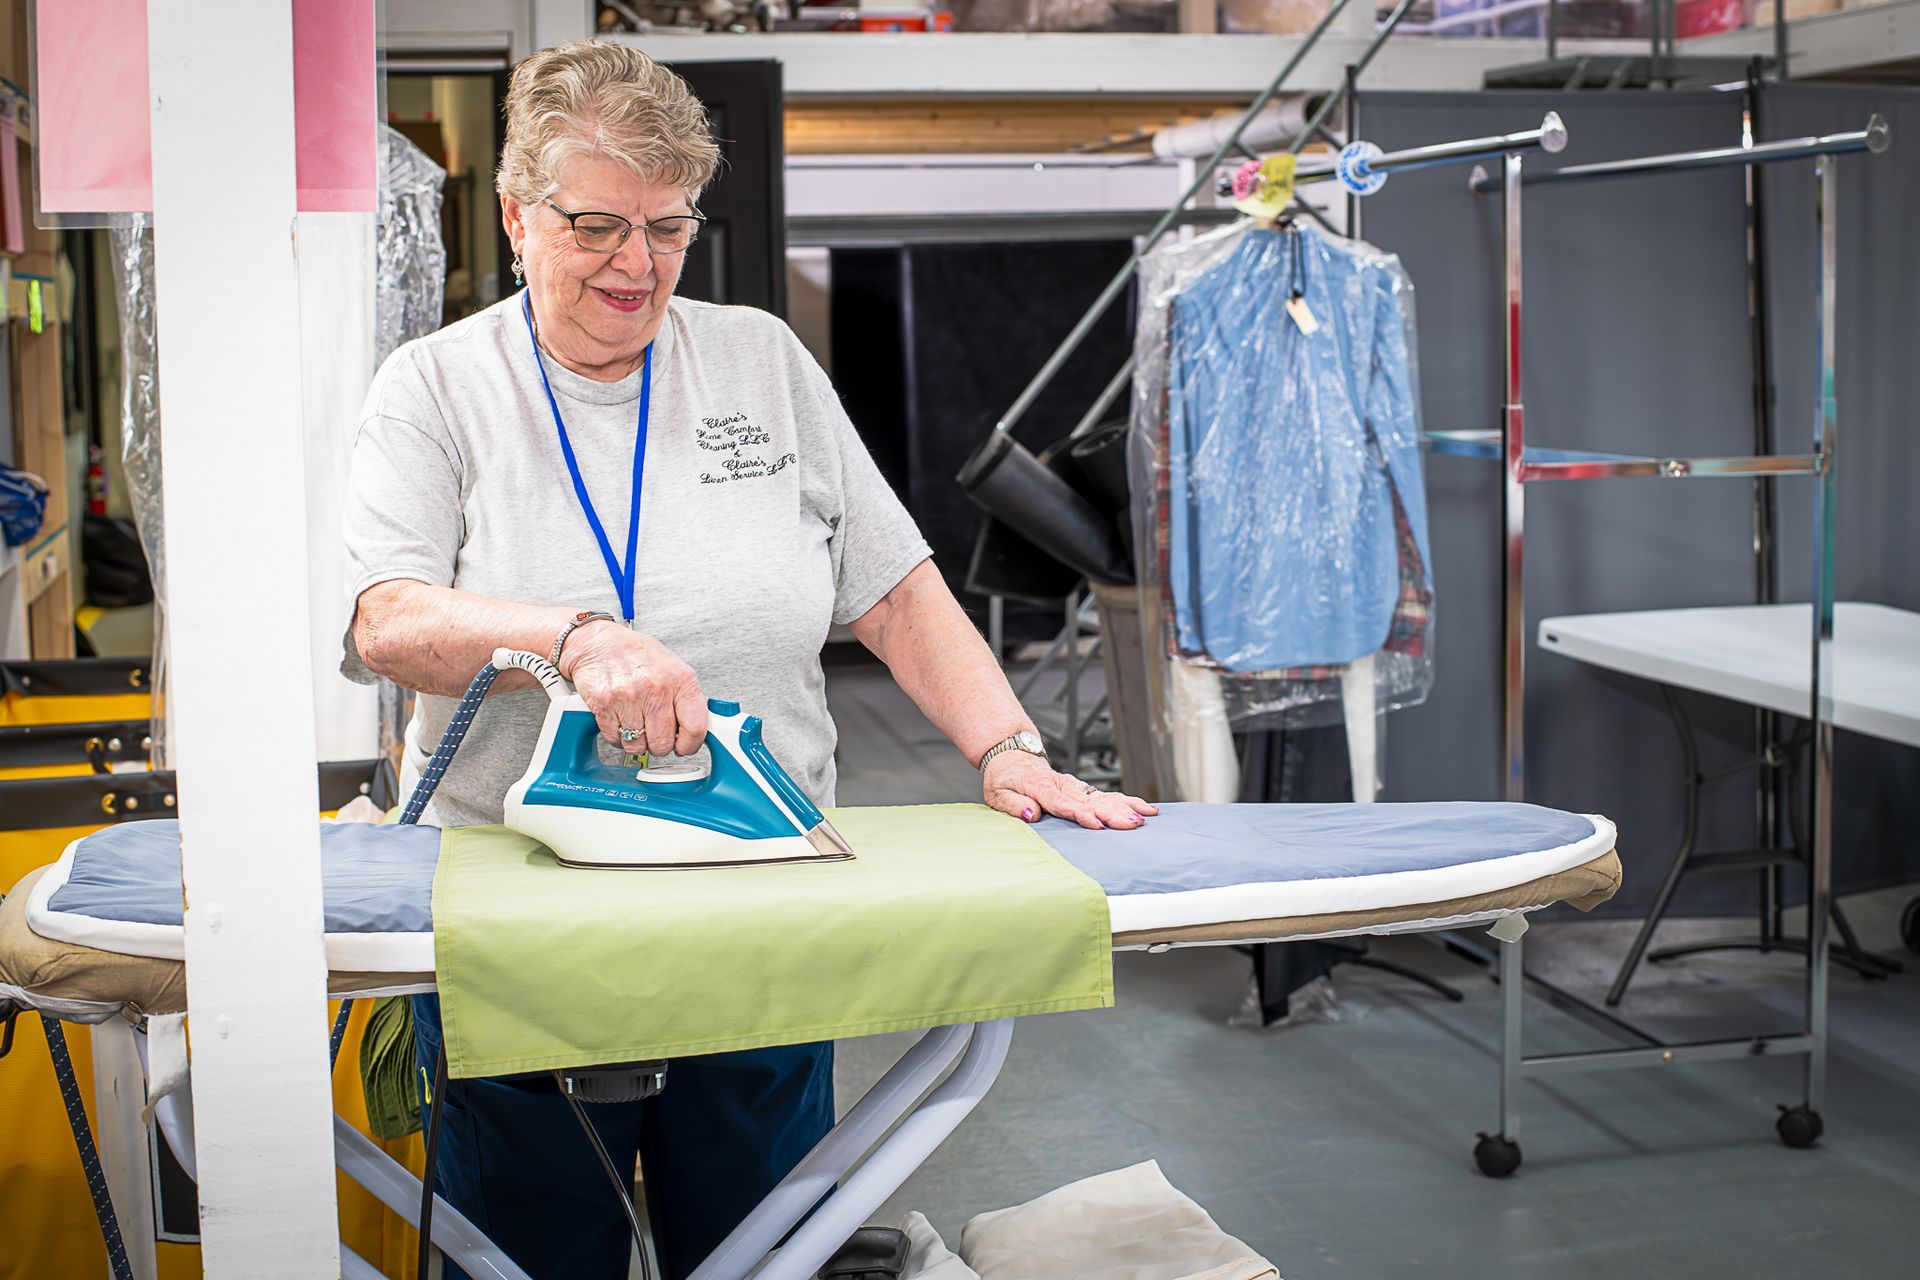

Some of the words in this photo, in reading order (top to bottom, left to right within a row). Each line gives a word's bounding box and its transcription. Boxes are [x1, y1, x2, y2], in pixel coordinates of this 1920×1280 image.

[702, 412, 747, 429] Claire's
[738, 433, 771, 445] LLC
[722, 456, 766, 471] Claire's
[730, 470, 764, 481] Service
[766, 453, 797, 476] LLC
